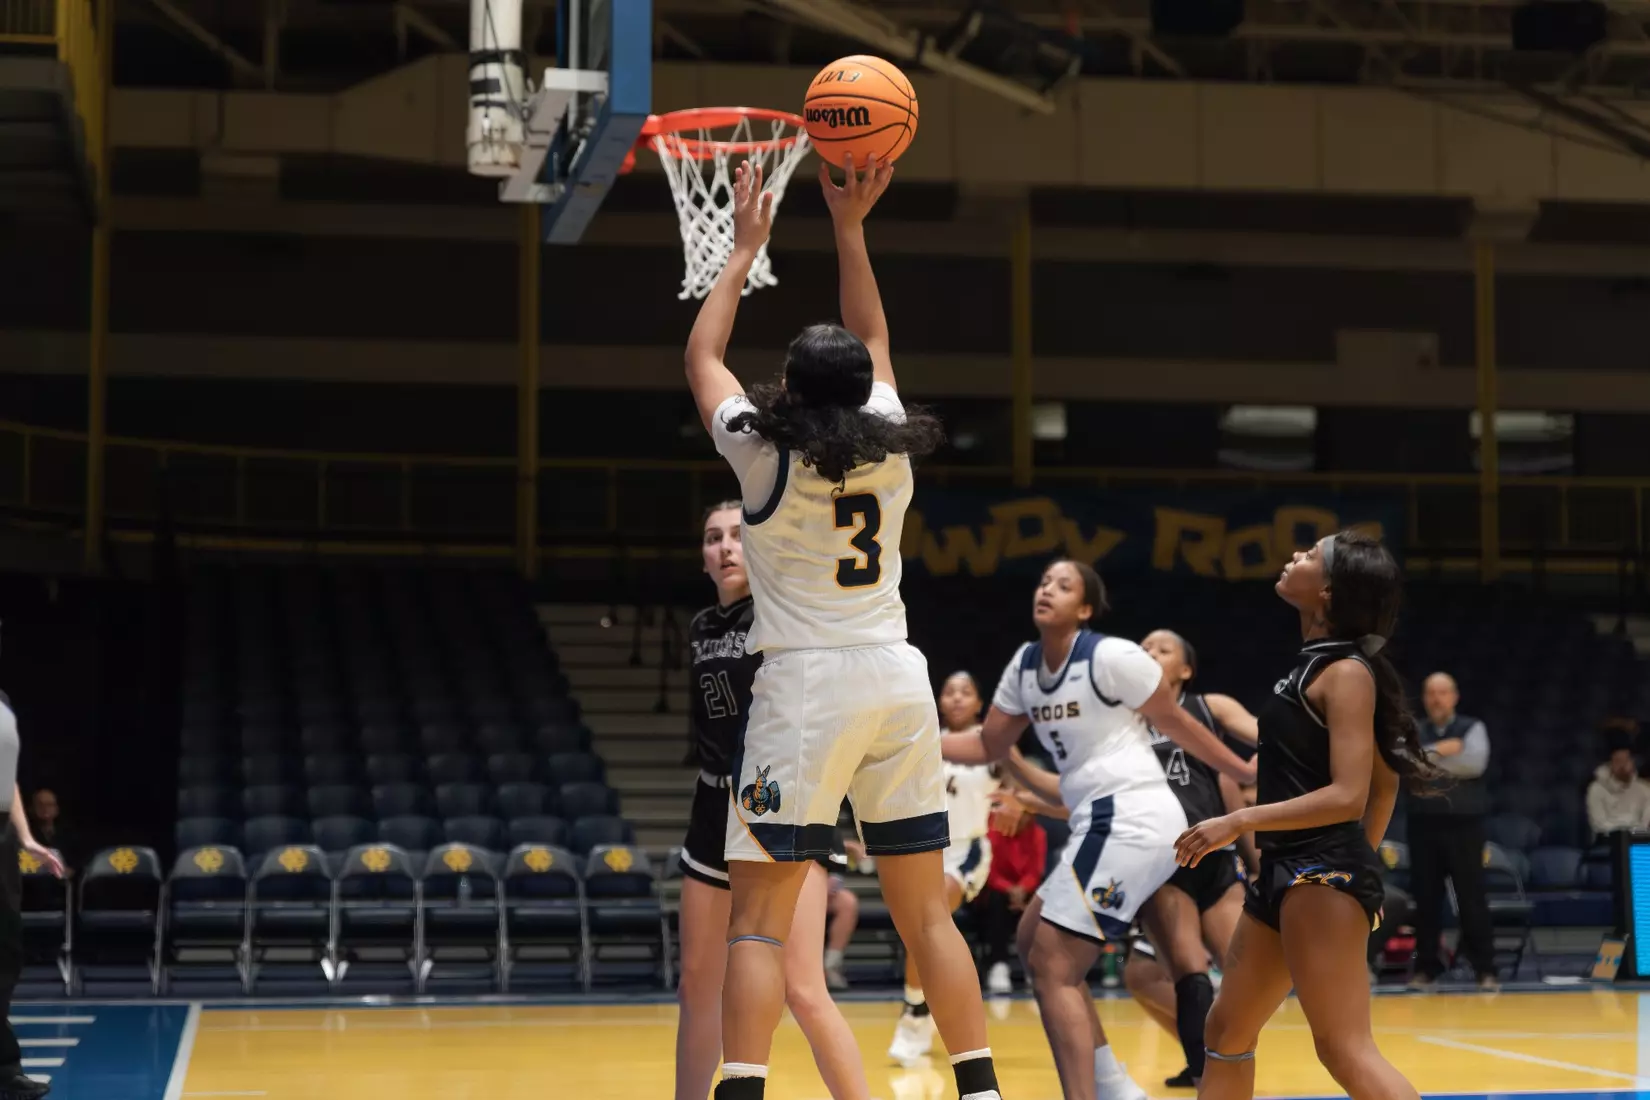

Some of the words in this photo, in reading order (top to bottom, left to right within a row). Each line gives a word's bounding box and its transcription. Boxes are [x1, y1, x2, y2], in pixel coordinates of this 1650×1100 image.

[805, 106, 872, 129] Wilson
[832, 490, 882, 589] 3
[1154, 505, 1384, 582] ROO
[699, 669, 738, 720] 21
